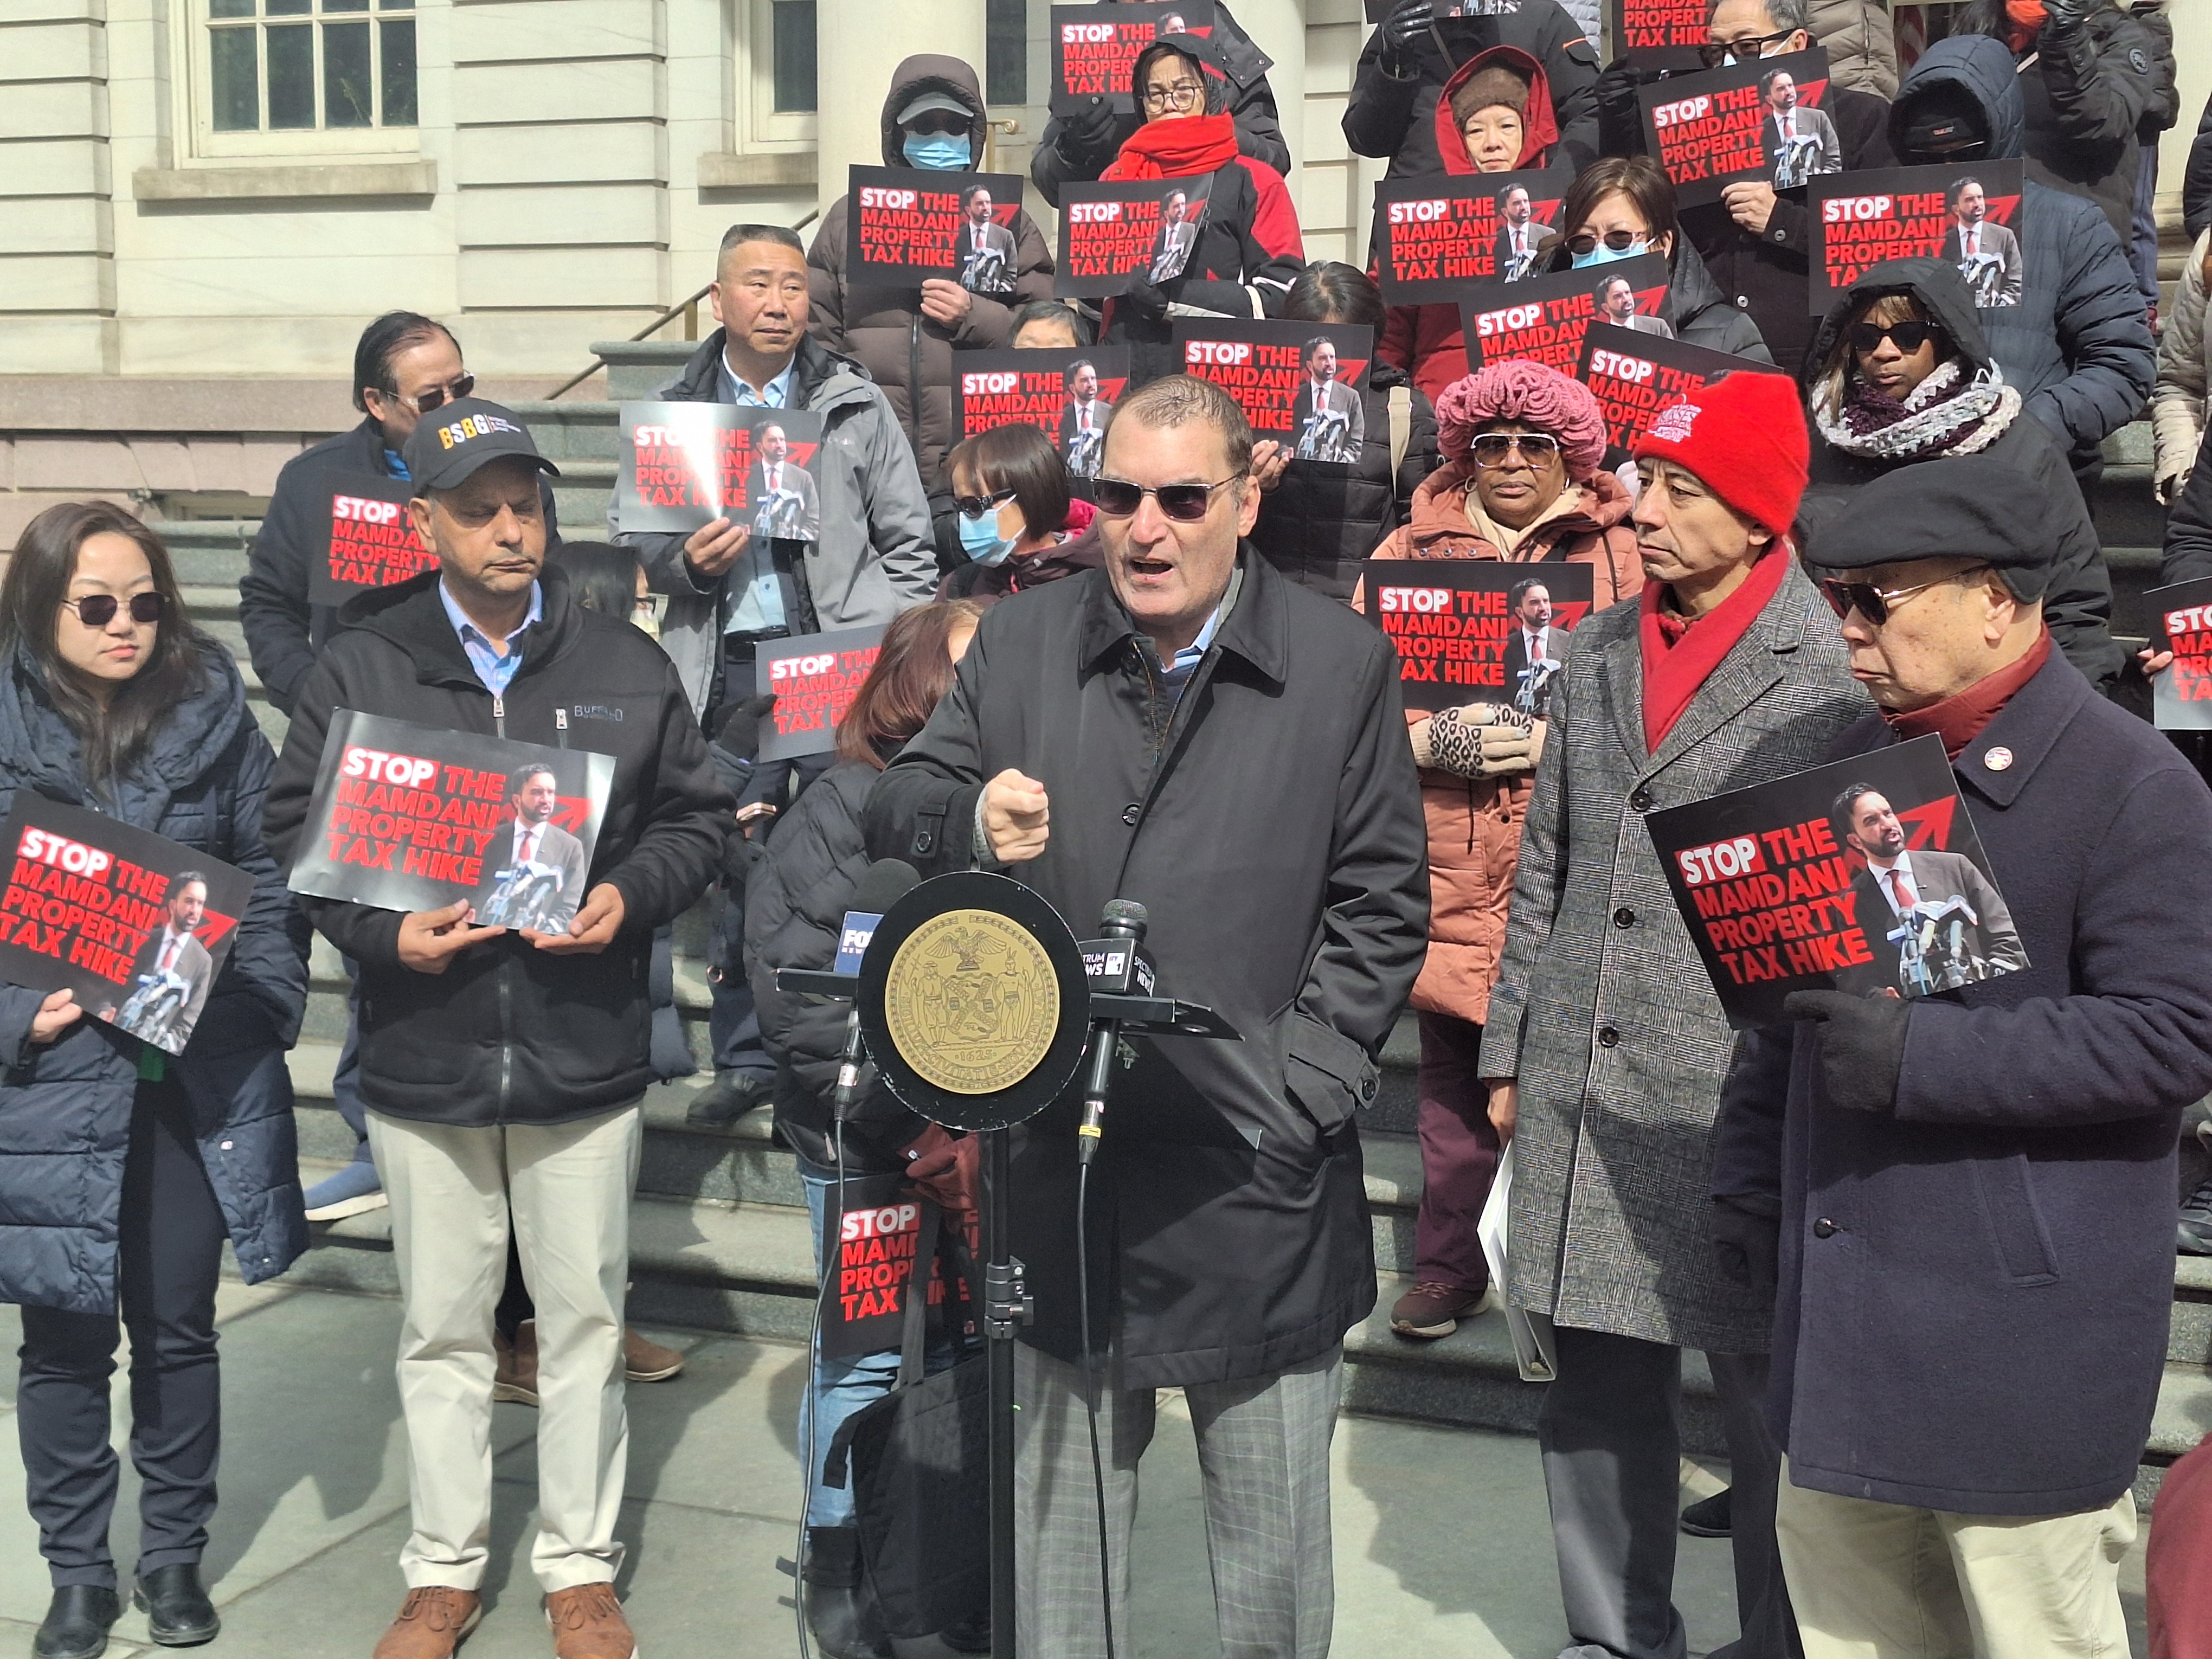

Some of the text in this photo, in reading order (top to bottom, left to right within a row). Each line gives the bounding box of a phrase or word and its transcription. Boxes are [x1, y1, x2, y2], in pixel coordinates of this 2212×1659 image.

[1624, 8, 1708, 27] PROPERT
[1063, 23, 1155, 42] STOP THE
[1624, 29, 1666, 47] TAX
[1064, 42, 1149, 59] MAMDAN
[1064, 59, 1136, 75] PROPER
[1064, 75, 1133, 94] TAX HI
[1655, 85, 1759, 126] STOP THE
[1658, 107, 1763, 147] MAMDANI
[1662, 126, 1764, 166] PROPERTY
[1666, 146, 1765, 185] TAX HIKE
[861, 188, 960, 211] STOP THE
[1071, 201, 1160, 222] STOP THE
[1390, 197, 1495, 222] STOP THE
[1825, 192, 1945, 221] STOP THE
[861, 208, 959, 230] MAMDANI
[1071, 220, 1159, 240] MAMDANI
[1391, 218, 1496, 243] MAMDANI
[1826, 217, 1945, 244] MAMDANI
[860, 226, 959, 248] PROPERTY
[1070, 237, 1156, 257] PROPERTY
[1392, 237, 1497, 261] PROPERTY
[860, 243, 955, 268] TAX HIKE
[1826, 238, 1945, 265] PROPERTY
[1070, 258, 1108, 276] TAX
[1393, 256, 1495, 281] TAX HIKE
[1827, 264, 1876, 287] TA
[1478, 293, 1596, 335] STOP THE
[1481, 318, 1589, 357] MAMDAN
[1187, 342, 1300, 368] STOP THE
[964, 372, 1063, 394] STOP THE
[1187, 364, 1299, 389] MAMDANI
[1592, 350, 1652, 382] STOP
[1660, 366, 1705, 391] THE
[964, 394, 1063, 414] MAMDANI
[1219, 387, 1299, 409] PERTY
[1588, 374, 1671, 411] MAMDA
[439, 414, 490, 449] BSBG
[713, 427, 750, 448] HE
[636, 467, 750, 487] PROPTY
[335, 496, 396, 524] STOP
[636, 486, 747, 509] TAX HKE
[332, 519, 425, 550] MAMDA
[330, 539, 441, 570] PROPERTY
[329, 559, 420, 587] TAX HI
[1381, 588, 1508, 615] STOP THE
[1382, 613, 1508, 639] MAMDANI
[1391, 636, 1509, 661] ROPERTY
[773, 654, 834, 679] STOP
[1400, 658, 1506, 686] AX HIKE
[773, 669, 871, 696] MAMDA
[773, 689, 857, 716] PROPER
[774, 711, 825, 735] TAX
[344, 749, 506, 801] STOP THE
[337, 778, 499, 829] MAMDANI
[330, 806, 494, 856] PROPERTY
[327, 833, 483, 886] TAX HIKE
[1681, 818, 1838, 884] STOP THE
[21, 829, 169, 904] STOP THE
[11, 858, 158, 932] MAMDANI
[1692, 857, 1851, 919] MAMDANI
[2, 885, 150, 956] PROPERTY
[1706, 892, 1856, 951] PROPERTY
[0, 912, 134, 985] TAX HIKE
[843, 929, 873, 948] FO
[1720, 928, 1874, 984] TAX HIKE
[841, 1205, 915, 1239] STOP
[841, 1287, 898, 1322] TAX
